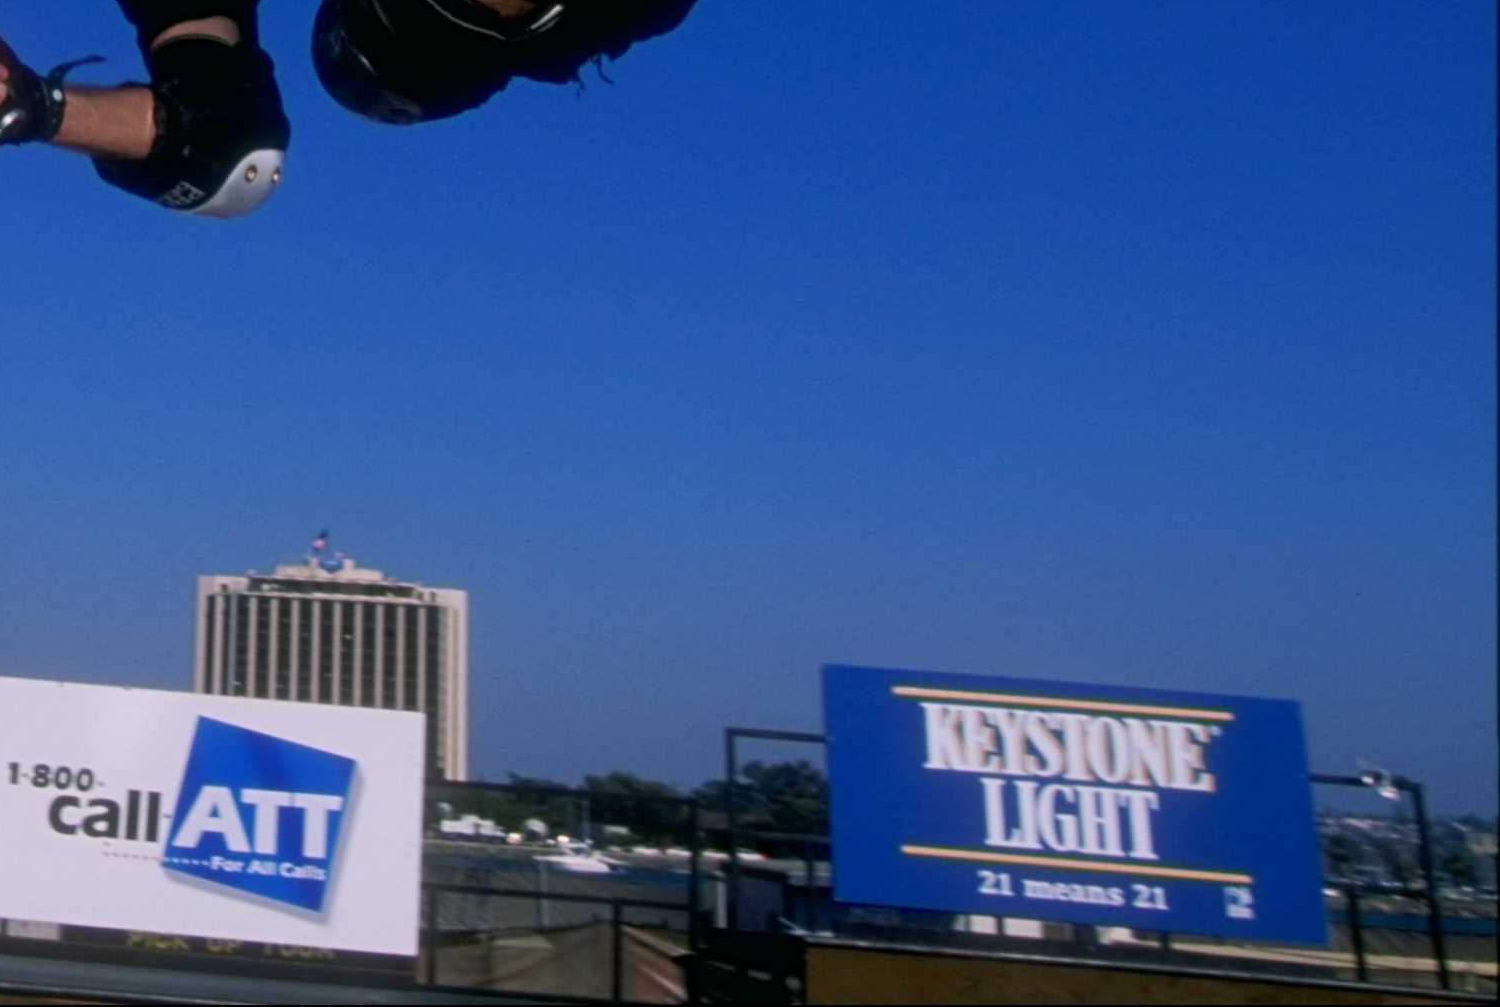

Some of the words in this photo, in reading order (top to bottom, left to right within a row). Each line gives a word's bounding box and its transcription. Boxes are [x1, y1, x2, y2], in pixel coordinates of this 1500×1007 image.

[920, 701, 1216, 793] KEYSTONE
[172, 785, 343, 859] ATT
[980, 778, 1160, 860] LIGHT
[209, 856, 244, 873] For
[247, 860, 277, 877] All
[978, 869, 1014, 897] 21
[1022, 877, 1124, 907] means
[1132, 883, 1169, 911] 21
